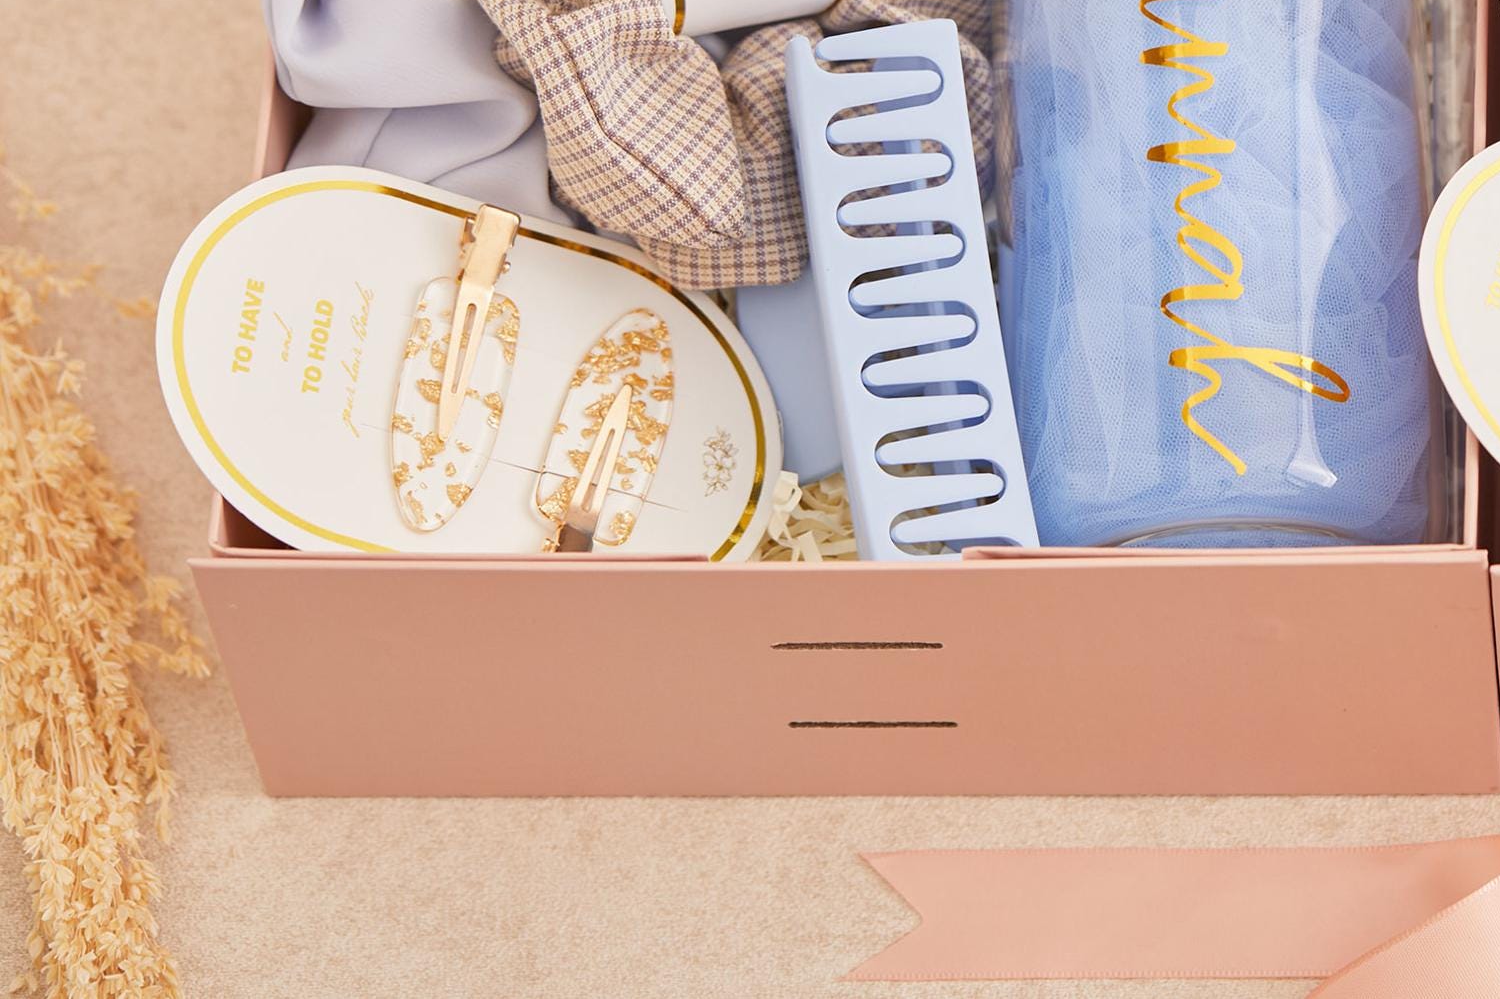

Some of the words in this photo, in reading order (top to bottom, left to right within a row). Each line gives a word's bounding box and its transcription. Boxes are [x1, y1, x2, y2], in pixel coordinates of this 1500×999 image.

[238, 278, 265, 341] HAVE
[308, 299, 334, 361] HOLD
[232, 346, 253, 372] TO
[302, 365, 322, 393] TO
